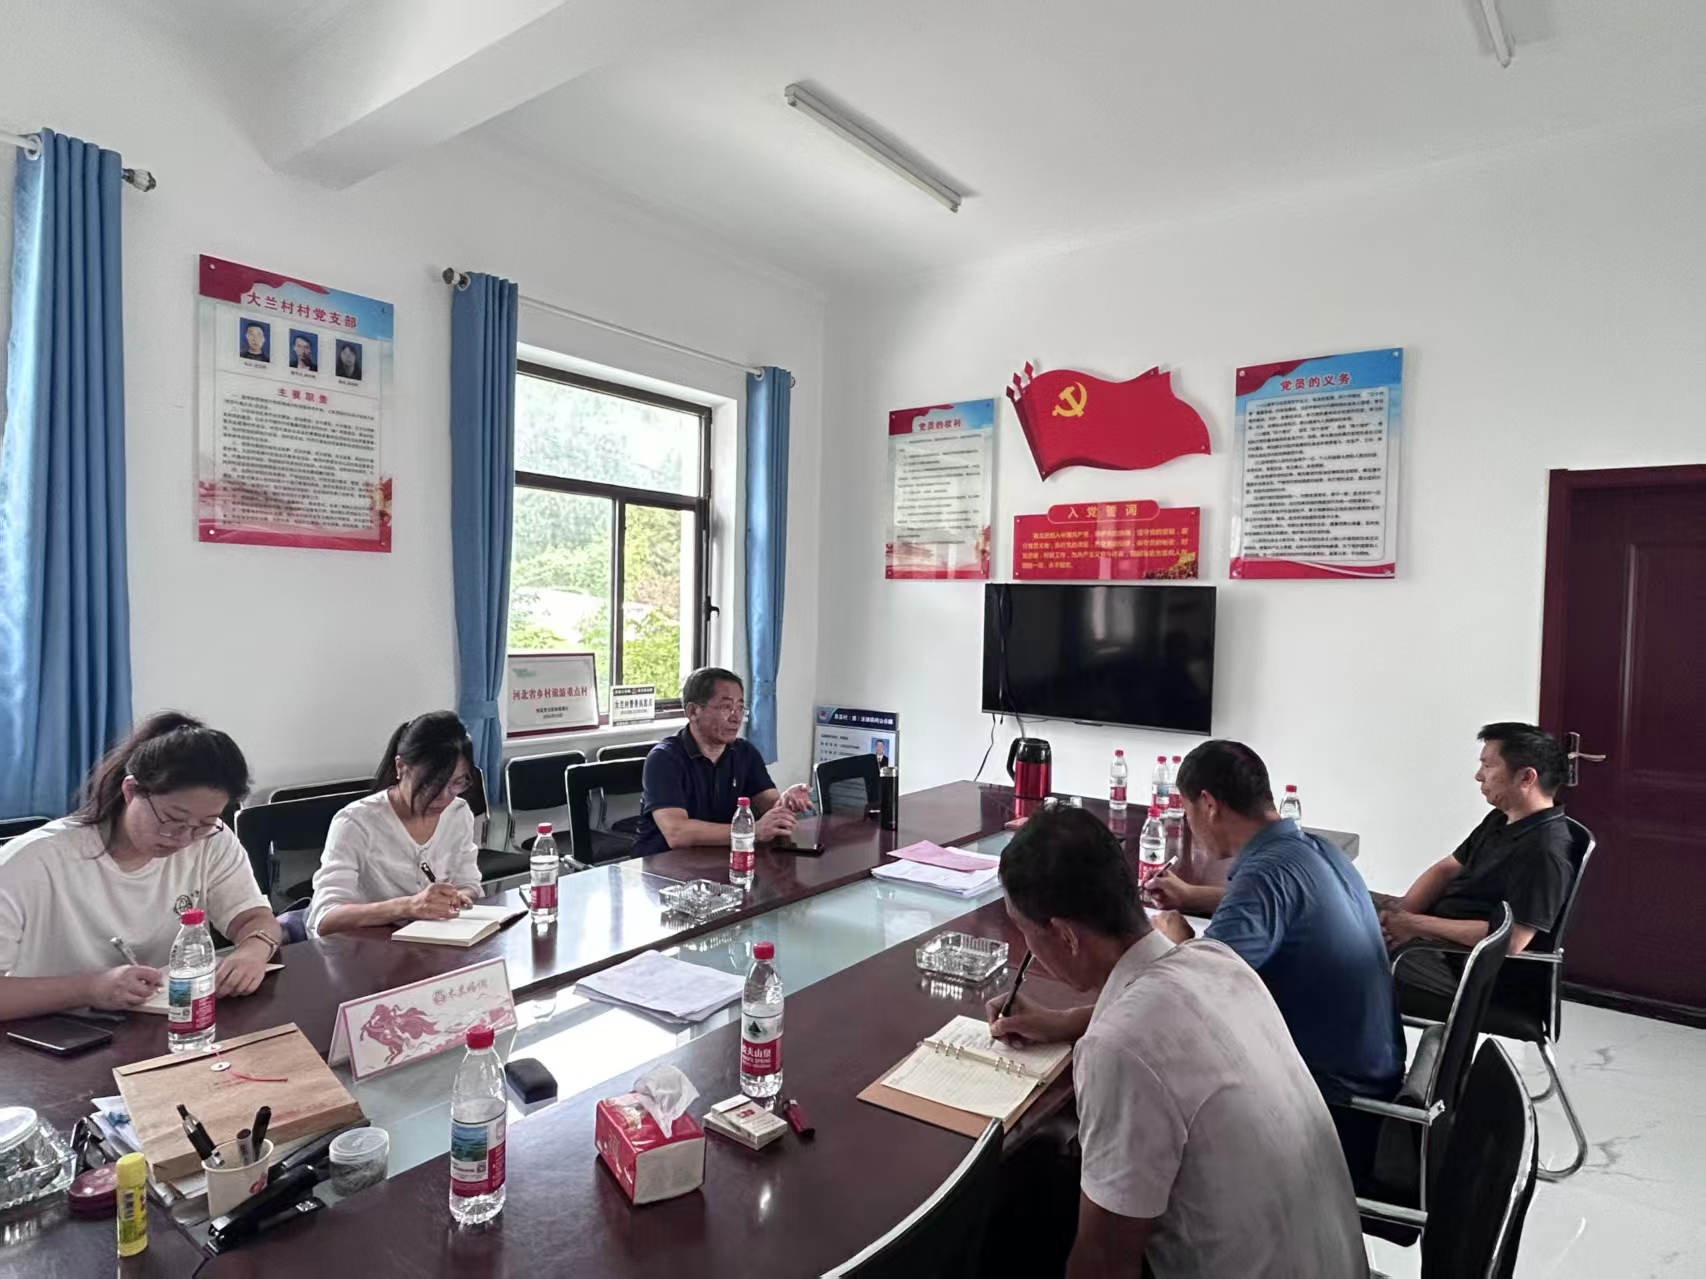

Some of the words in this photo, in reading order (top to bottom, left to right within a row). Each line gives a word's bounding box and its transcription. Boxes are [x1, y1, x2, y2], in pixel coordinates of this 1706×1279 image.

[247, 291, 358, 329] 大兰村村党支部
[1280, 372, 1351, 392] 党员的义务
[918, 418, 962, 431] 党员的权利
[1067, 503, 1138, 518] 入党誓词
[512, 686, 588, 701] 河北省乡村旅游重点村
